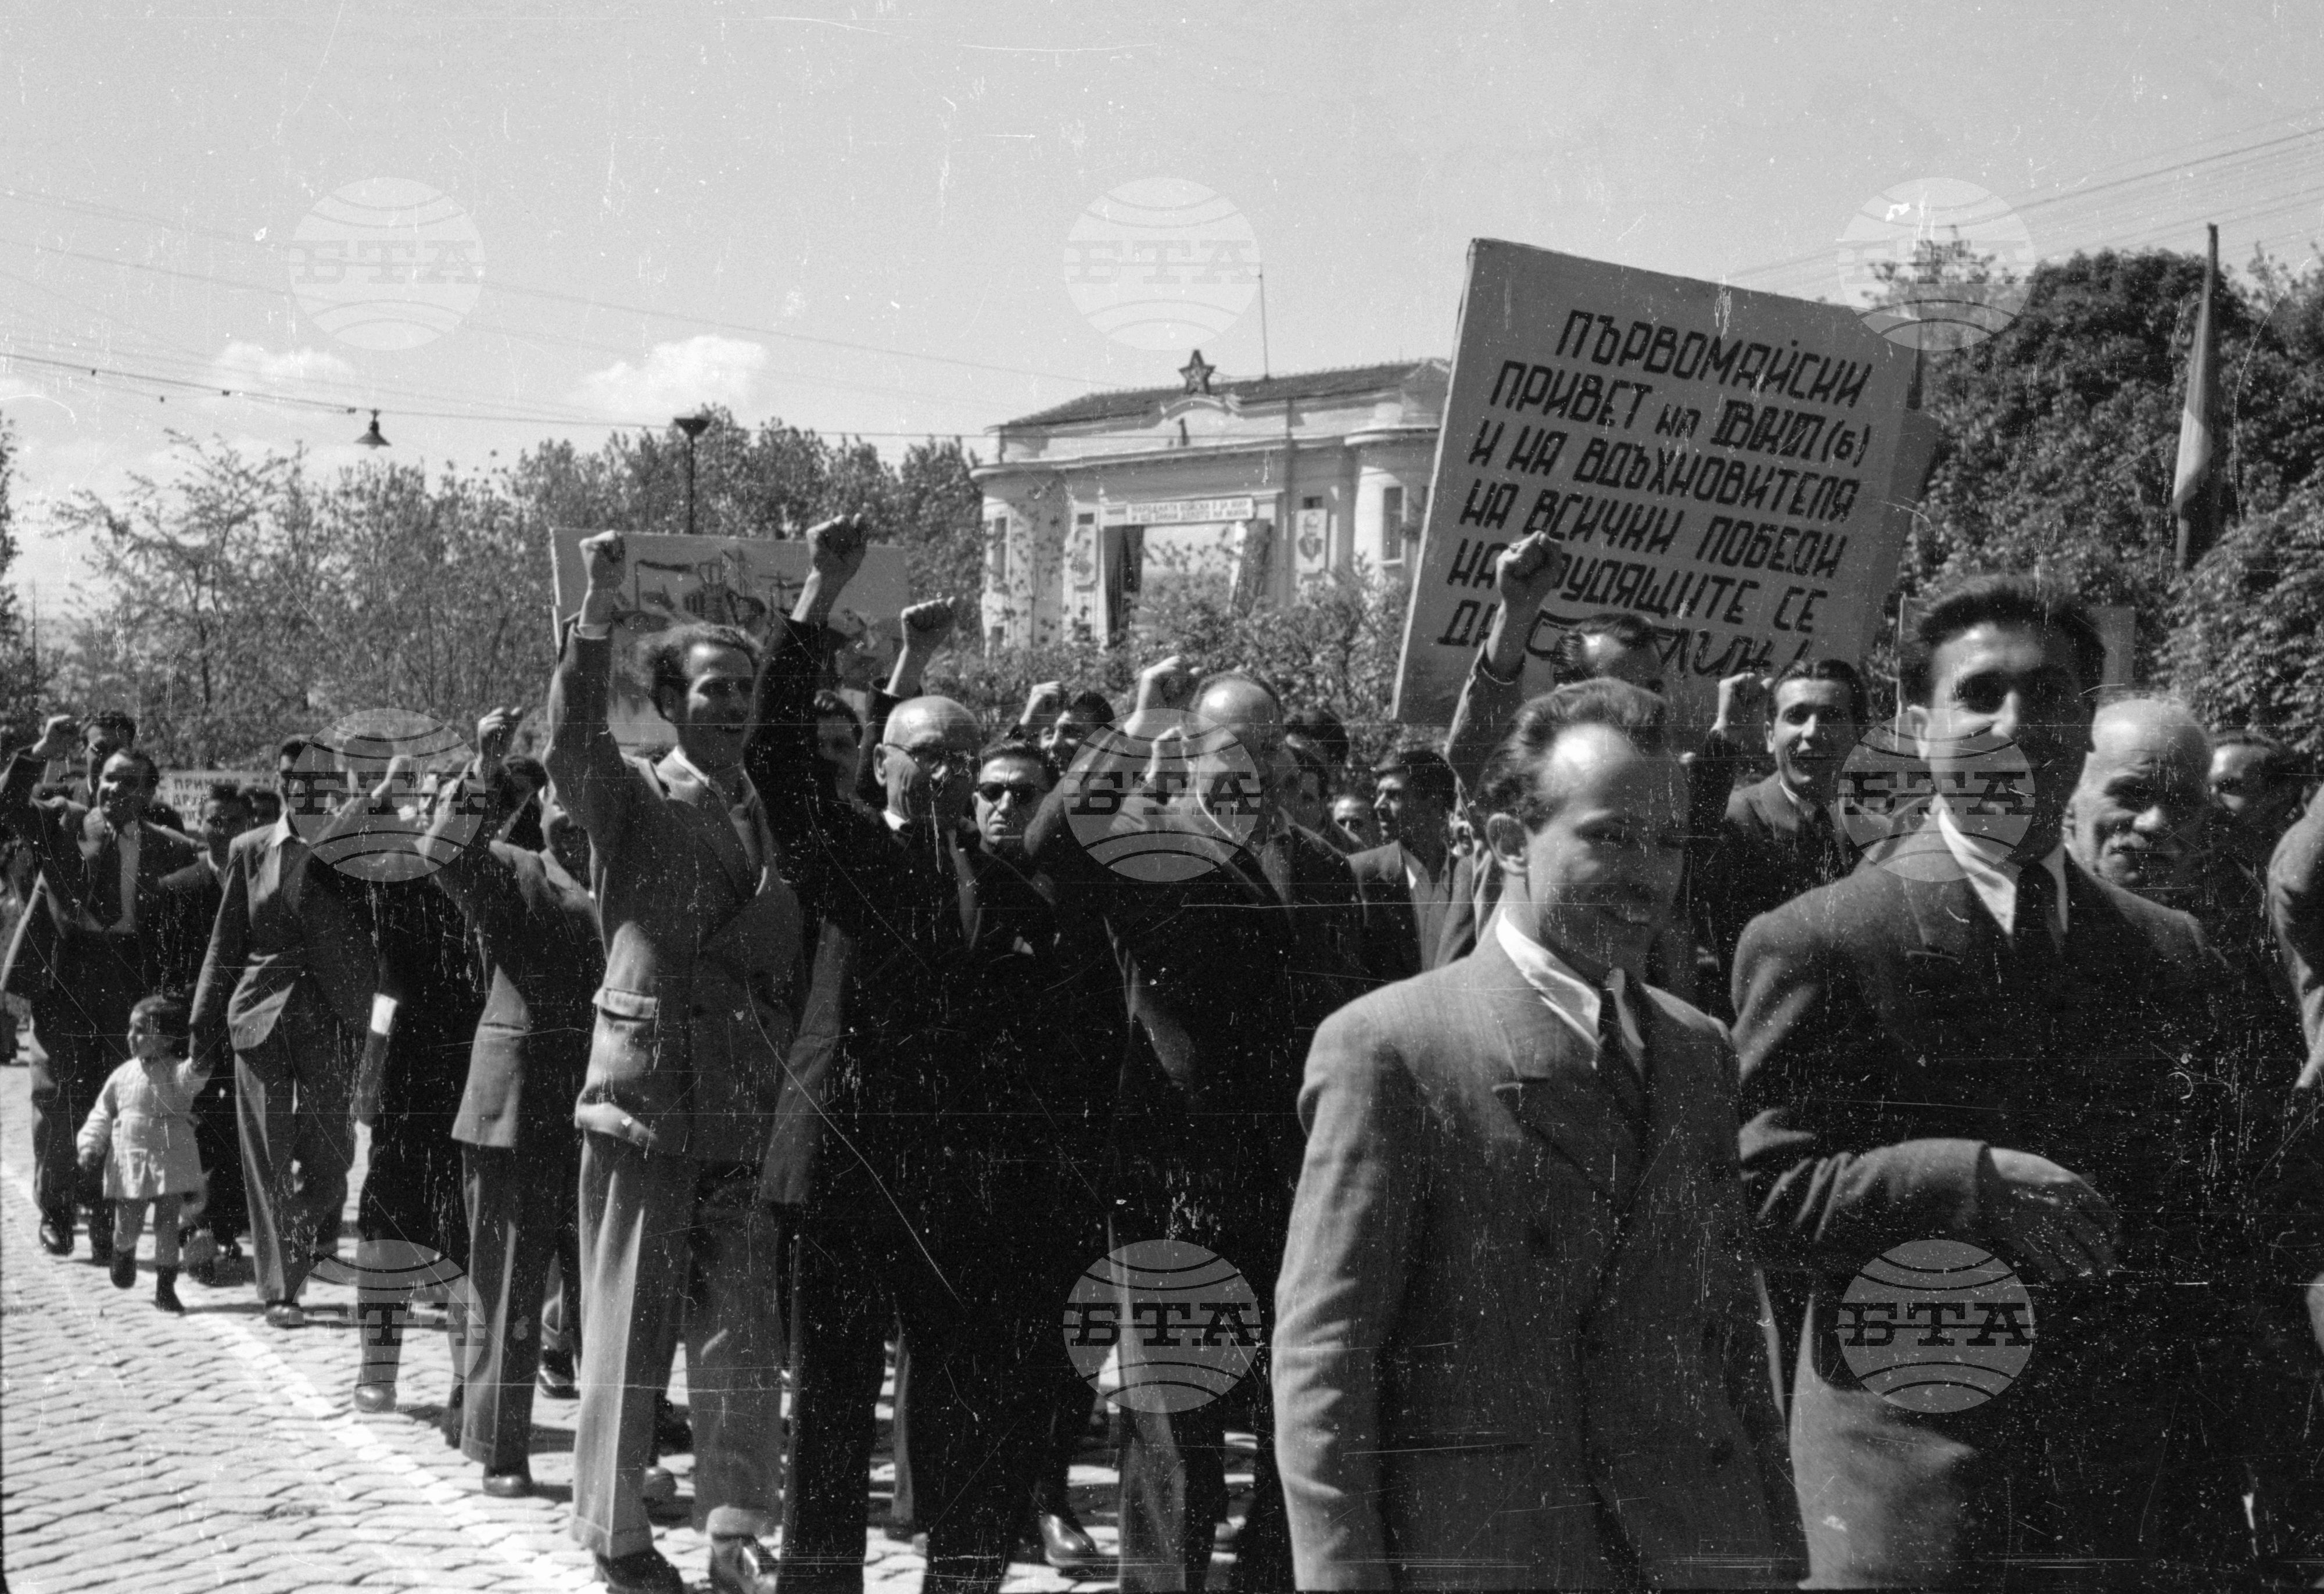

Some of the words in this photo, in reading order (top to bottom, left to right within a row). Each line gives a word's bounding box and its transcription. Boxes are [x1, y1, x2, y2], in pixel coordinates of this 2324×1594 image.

[1490, 360, 1652, 429] ПРИВЕТ
[1555, 310, 1872, 407] ПЪРВОМАЙСКИ
[1468, 420, 1505, 467] И
[1505, 425, 1568, 476] НА
[1573, 437, 1860, 521] ВДЪХНОВИТЕЛЯ
[1459, 479, 1519, 529] НА
[1523, 489, 1684, 554] ВСИЧКИ
[1697, 516, 1847, 578] ПОБЕДИ
[1774, 586, 1828, 633] СЕ
